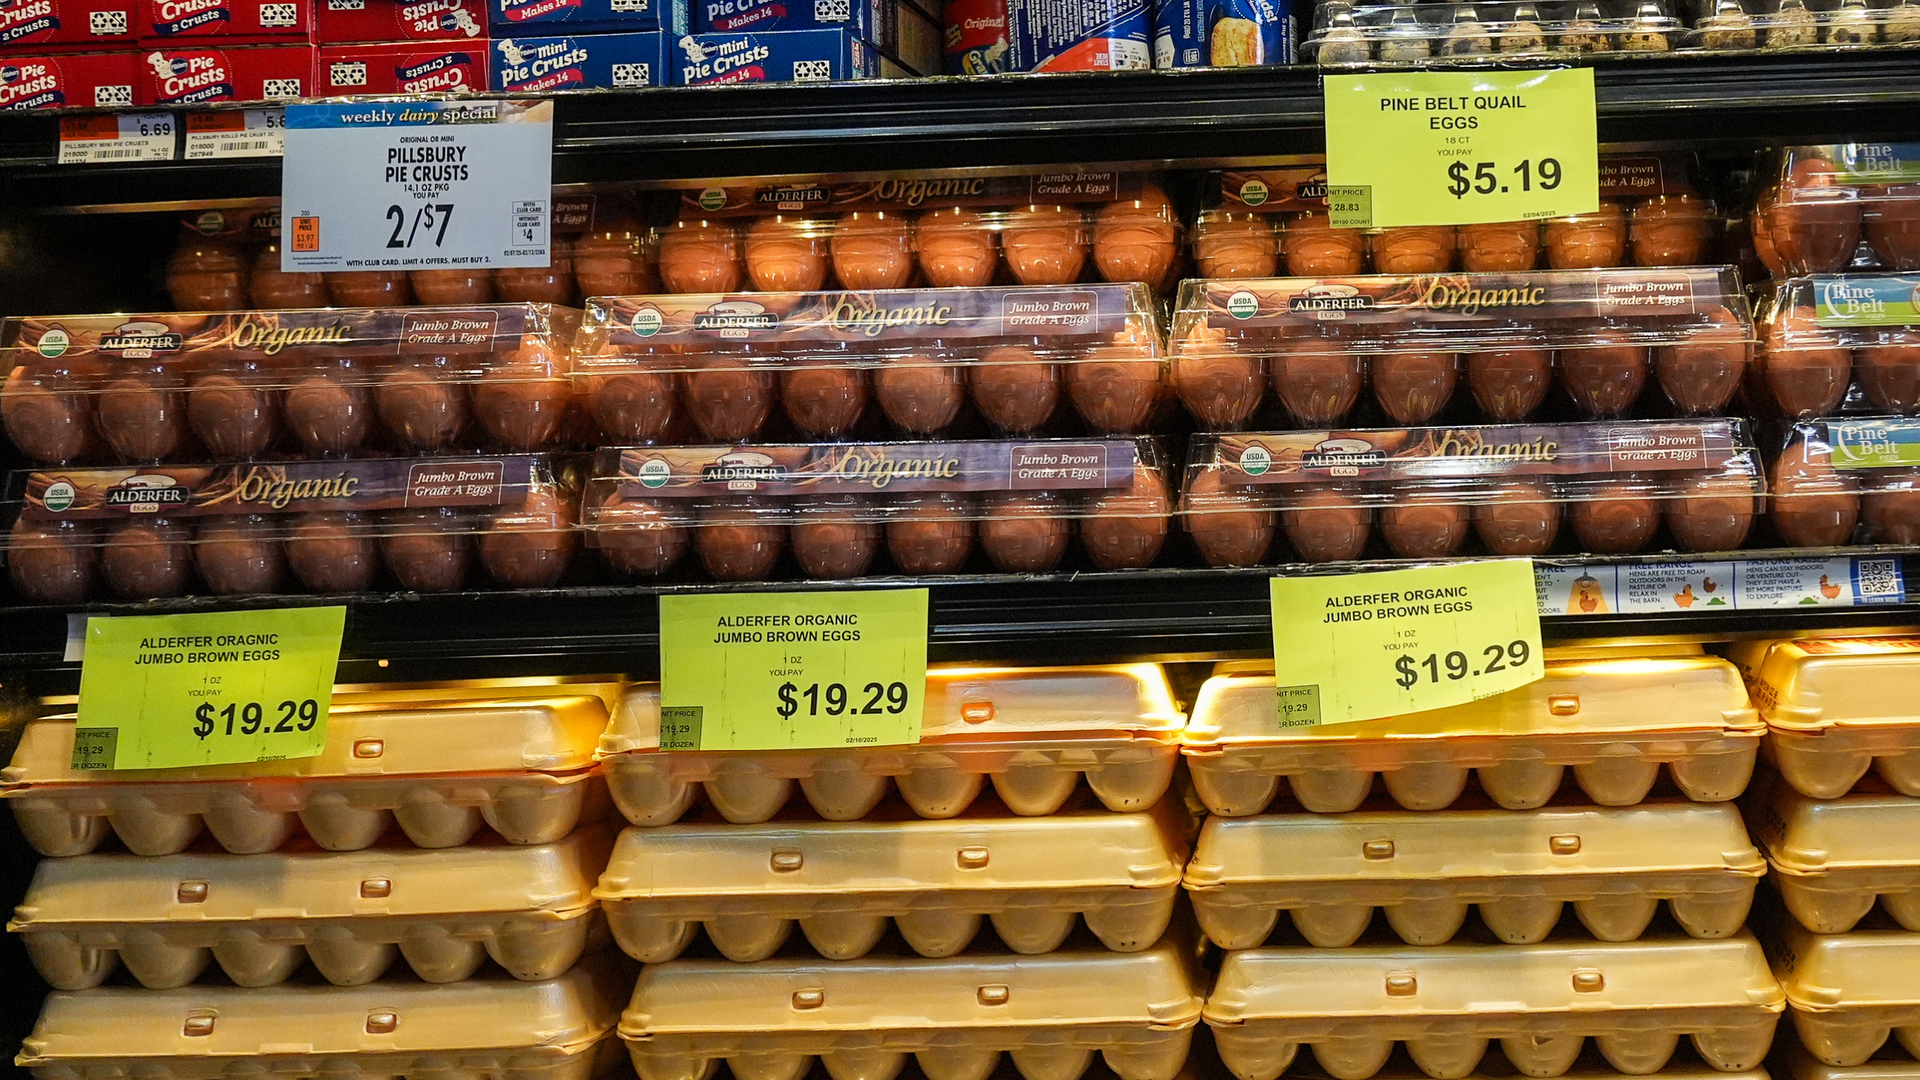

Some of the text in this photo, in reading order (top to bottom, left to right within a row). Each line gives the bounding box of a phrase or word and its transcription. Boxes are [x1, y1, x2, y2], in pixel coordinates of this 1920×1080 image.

[521, 3, 554, 19] Makes
[728, 7, 773, 29] Makes 14
[171, 10, 219, 32] 2 Crusts
[965, 16, 1005, 29] Original
[2, 19, 49, 40] 2 Crusts
[537, 40, 567, 58] mini
[719, 37, 749, 56] mini
[189, 57, 215, 73] Pie
[501, 48, 588, 87] pie Crusts
[683, 45, 769, 84] pie Crusts
[21, 64, 46, 81] Pie
[556, 72, 569, 84] 14
[164, 68, 225, 95] Crusts
[1381, 95, 1526, 111] PINE BELT QUAIL
[341, 107, 498, 126] weekly dairy special
[1430, 116, 1478, 130] EGGS
[140, 123, 171, 137] 6.69
[400, 135, 455, 144] ORIGINAL OR MINI
[387, 145, 467, 164] PILLSBURY
[385, 164, 469, 183] PIE CRUSTS
[1447, 157, 1562, 200] $5.19
[403, 183, 450, 192] 14.1 OZ PKG
[760, 190, 822, 202] ALDERFER
[1334, 203, 1360, 212] 28.83
[297, 234, 314, 242] $3.97
[523, 229, 533, 241] $4
[346, 259, 363, 267] WITH
[365, 259, 379, 267] CLUB
[381, 258, 401, 266] CARD.
[402, 258, 417, 266] LIMIT
[419, 257, 424, 265] 4
[426, 257, 449, 265] OFFERS.
[451, 256, 469, 264] MUST
[470, 256, 483, 264] BUY
[485, 255, 491, 263] 2.
[1832, 284, 1875, 299] Pine
[1295, 298, 1367, 311] ALDERFER
[1427, 282, 1545, 317] Organic
[1009, 301, 1090, 314] Jumbo Brown
[1847, 299, 1886, 315] Belt
[700, 316, 771, 329] ALDERFER
[834, 300, 951, 337] Organic
[1010, 314, 1089, 326] Grade A Eggs
[409, 320, 489, 332] Jumbo Brown
[723, 329, 746, 337] EGGS
[103, 337, 175, 349] ALDERFER
[233, 317, 351, 355] Organic
[408, 333, 486, 344] Grade A Eggs
[1846, 427, 1887, 441] Pine
[1860, 441, 1899, 455] Belt
[1018, 454, 1098, 466] Jumbo Brown
[1308, 454, 1379, 467] ALDERFER
[415, 471, 494, 484] Jumbo Brown
[707, 468, 778, 480] ALDERFER
[841, 453, 958, 488] Organic
[1019, 467, 1098, 479] Grade A Eggs
[242, 471, 359, 509] Organic
[415, 484, 493, 496] Grade A Eggs
[731, 481, 754, 489] EGGS
[110, 490, 181, 502] ALDERFER
[1325, 586, 1468, 608] ALDERFER ORGANIC
[1323, 601, 1473, 624] JUMBO BROWN EGGS
[718, 614, 858, 627] ALDERFER ORGANIC
[140, 634, 279, 649] ALDERFER ORAGNIC
[714, 630, 861, 643] JUMBO BROWN EGGS
[135, 649, 280, 665] JUMBO BROWN EGGS
[790, 656, 802, 664] DZ
[1395, 640, 1530, 690] $19.29
[769, 669, 786, 677] YOU
[776, 681, 908, 721] $19.29
[1282, 704, 1308, 713] 19.29
[193, 699, 319, 740] $19.29
[1289, 719, 1315, 727] DOZEN
[665, 725, 690, 733] 19.29
